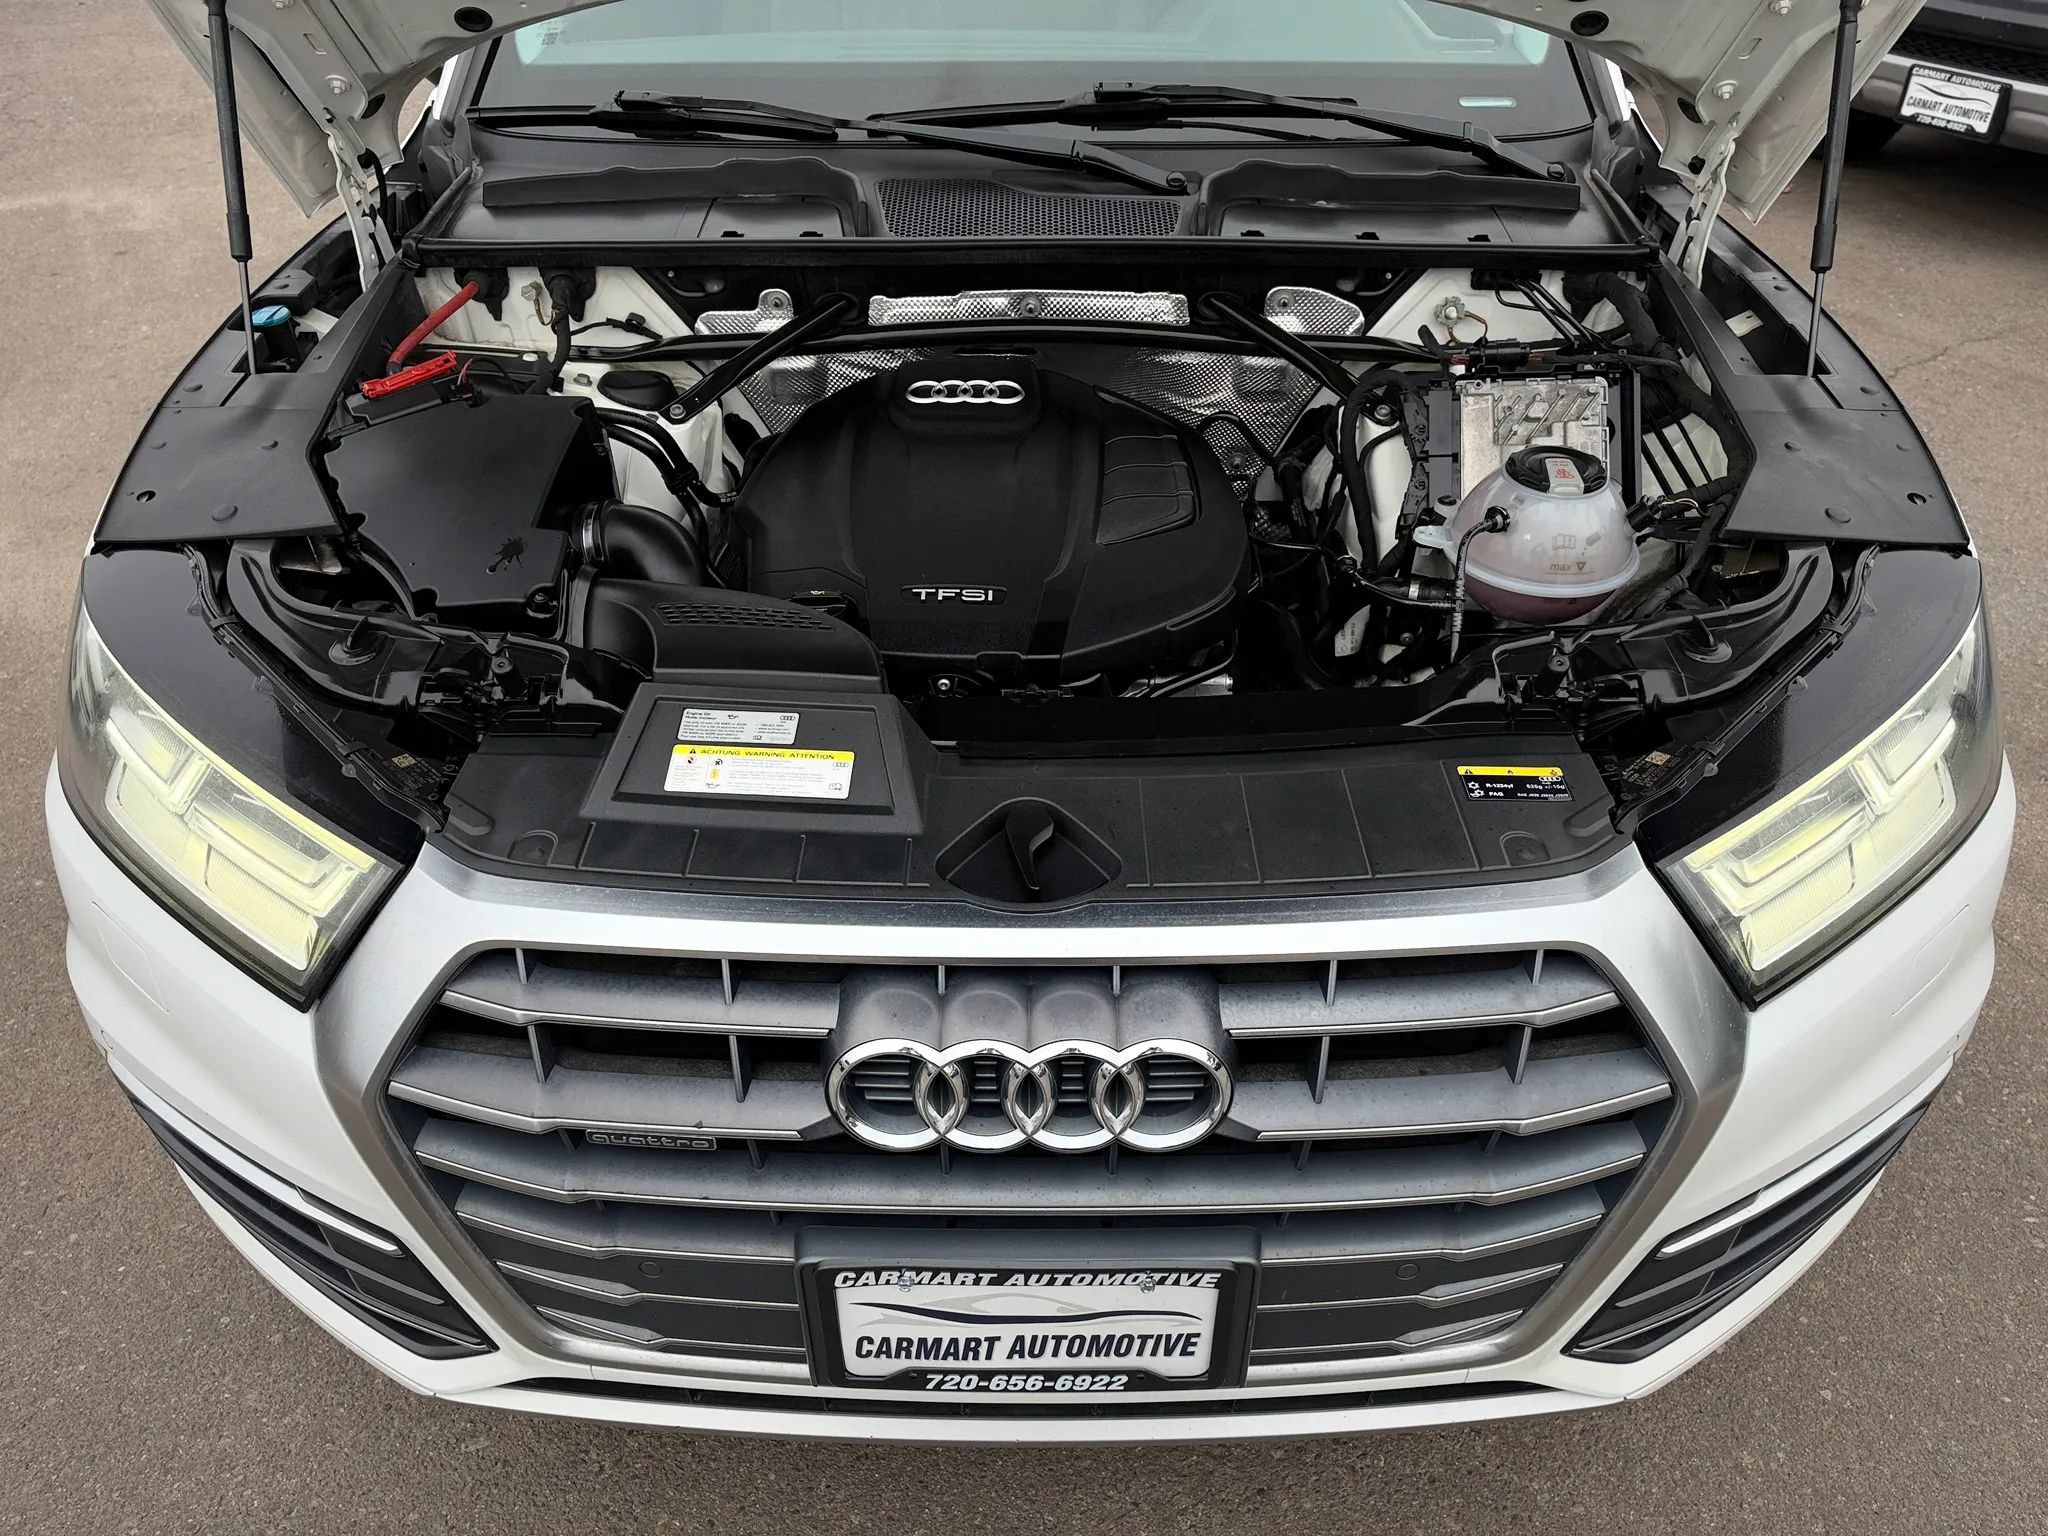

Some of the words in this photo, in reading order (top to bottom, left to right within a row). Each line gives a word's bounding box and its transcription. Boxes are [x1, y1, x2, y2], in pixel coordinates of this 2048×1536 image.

[1912, 67, 1951, 81] CARMART
[1950, 75, 2001, 92] AUTOMOTIVE
[1906, 96, 1943, 112] CARMART
[1943, 103, 1990, 123] AUTOMOTIVE
[912, 588, 993, 601] TFSI
[592, 1134, 709, 1147] quattro
[834, 1271, 999, 1288] CARMART
[1004, 1272, 1221, 1288] AUTOMOTIVE
[855, 1335, 1001, 1361] CARMART
[1006, 1332, 1201, 1360] AUTOMOTIVE
[925, 1373, 1129, 1391] 720-656-6922
